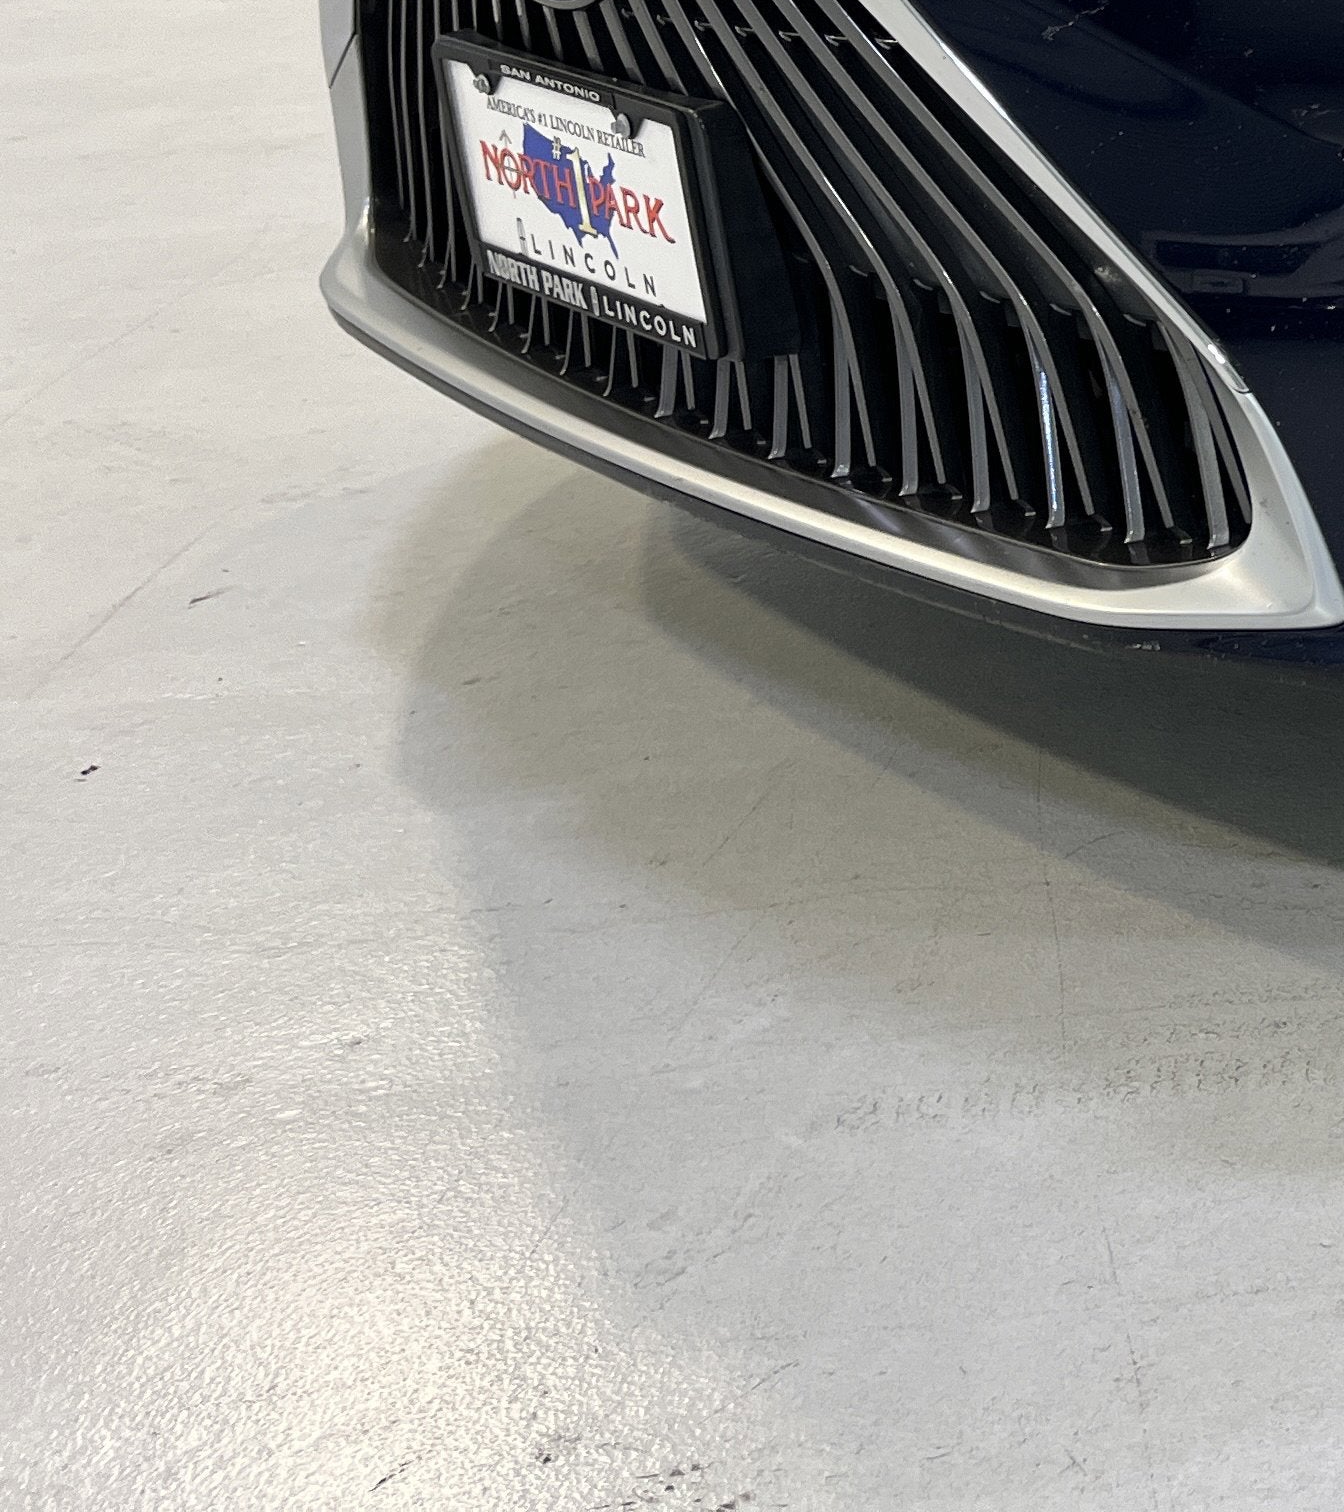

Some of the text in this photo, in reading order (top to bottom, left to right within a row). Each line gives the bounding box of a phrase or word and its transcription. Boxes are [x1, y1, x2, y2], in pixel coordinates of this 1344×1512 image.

[500, 64, 600, 102] SAN ANTONIO
[486, 95, 646, 158] AMERICA'S #1 LINCOLN RETAILER
[479, 139, 677, 245] NORTH PARK
[530, 233, 657, 297] LINCOLN
[486, 249, 697, 348] NORTH PARK LINCOLN
